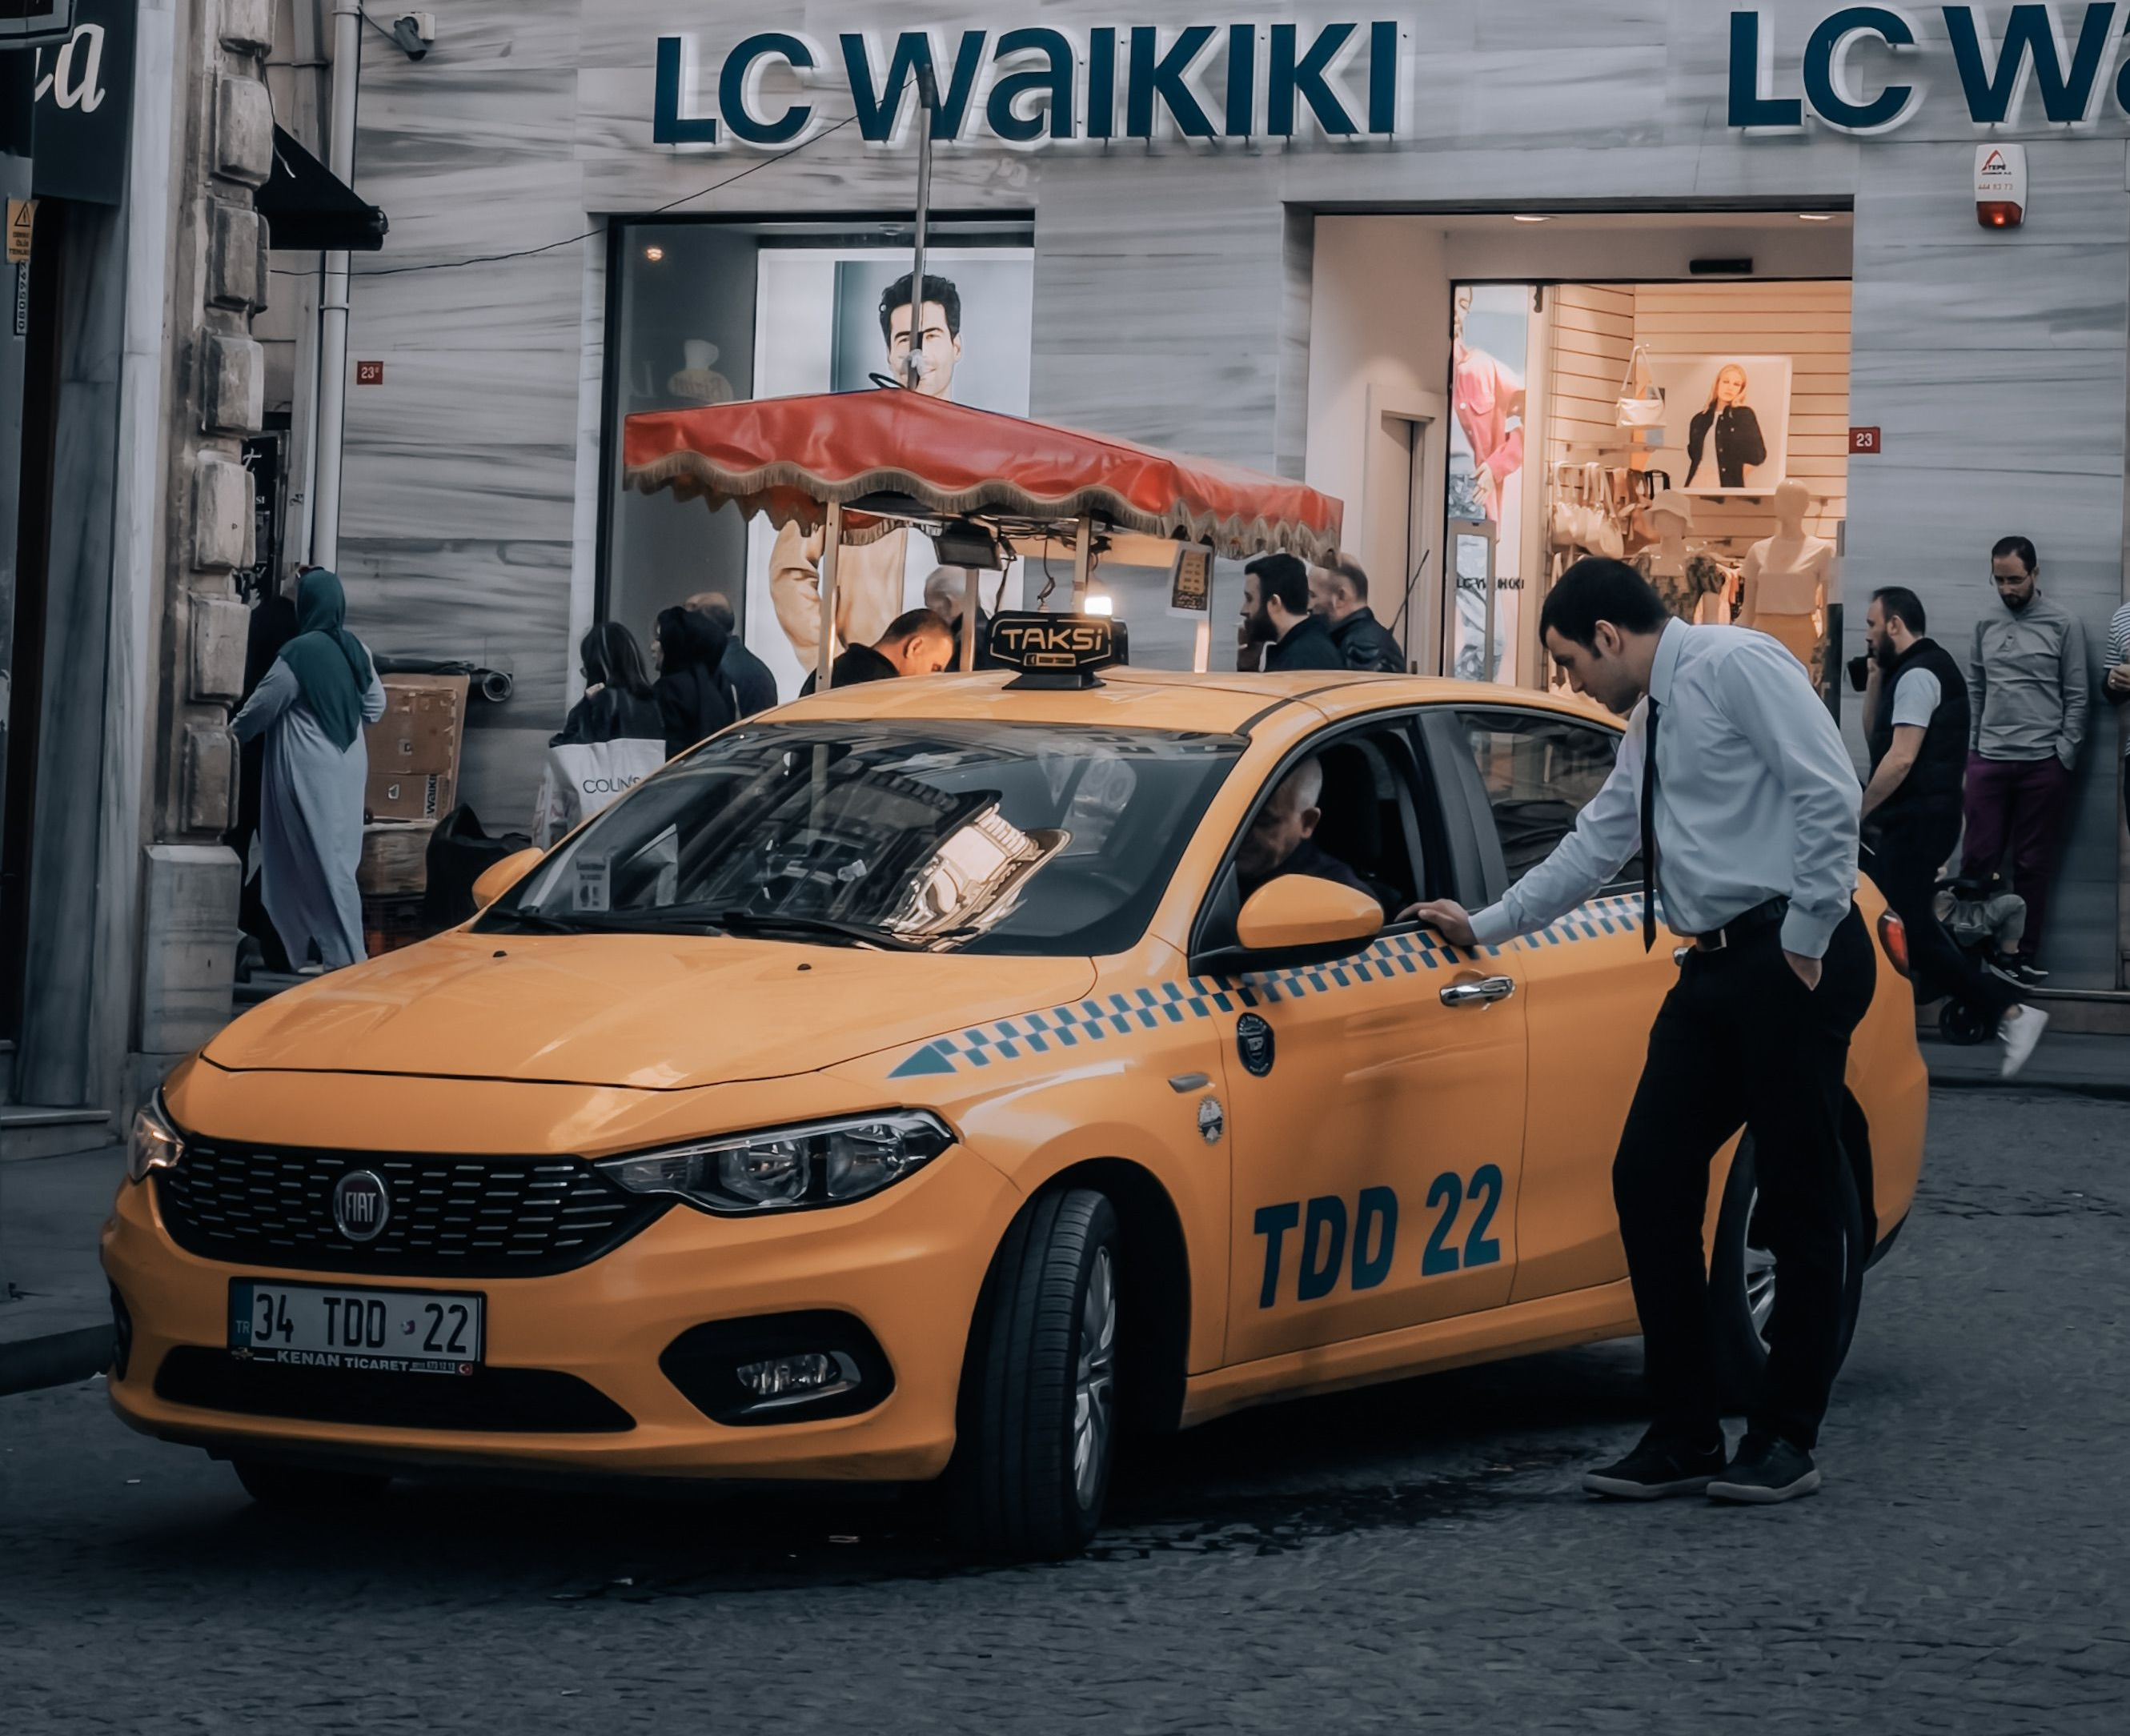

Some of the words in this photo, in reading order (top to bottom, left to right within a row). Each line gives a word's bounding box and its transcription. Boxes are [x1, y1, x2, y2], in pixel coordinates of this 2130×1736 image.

[35, 23, 106, 113] a
[653, 33, 815, 144] LC
[1727, 6, 1915, 129] LC
[1941, 2, 2130, 123] W
[1856, 432, 1872, 447] 23
[345, 1191, 376, 1222] FIAT
[1254, 1185, 1398, 1309] TDD
[1422, 1163, 1502, 1277] 22
[236, 1320, 251, 1334] TR
[255, 1293, 294, 1343] 34
[323, 1297, 386, 1349] TDD
[423, 1303, 467, 1353] 22
[277, 1349, 340, 1367] KENAN
